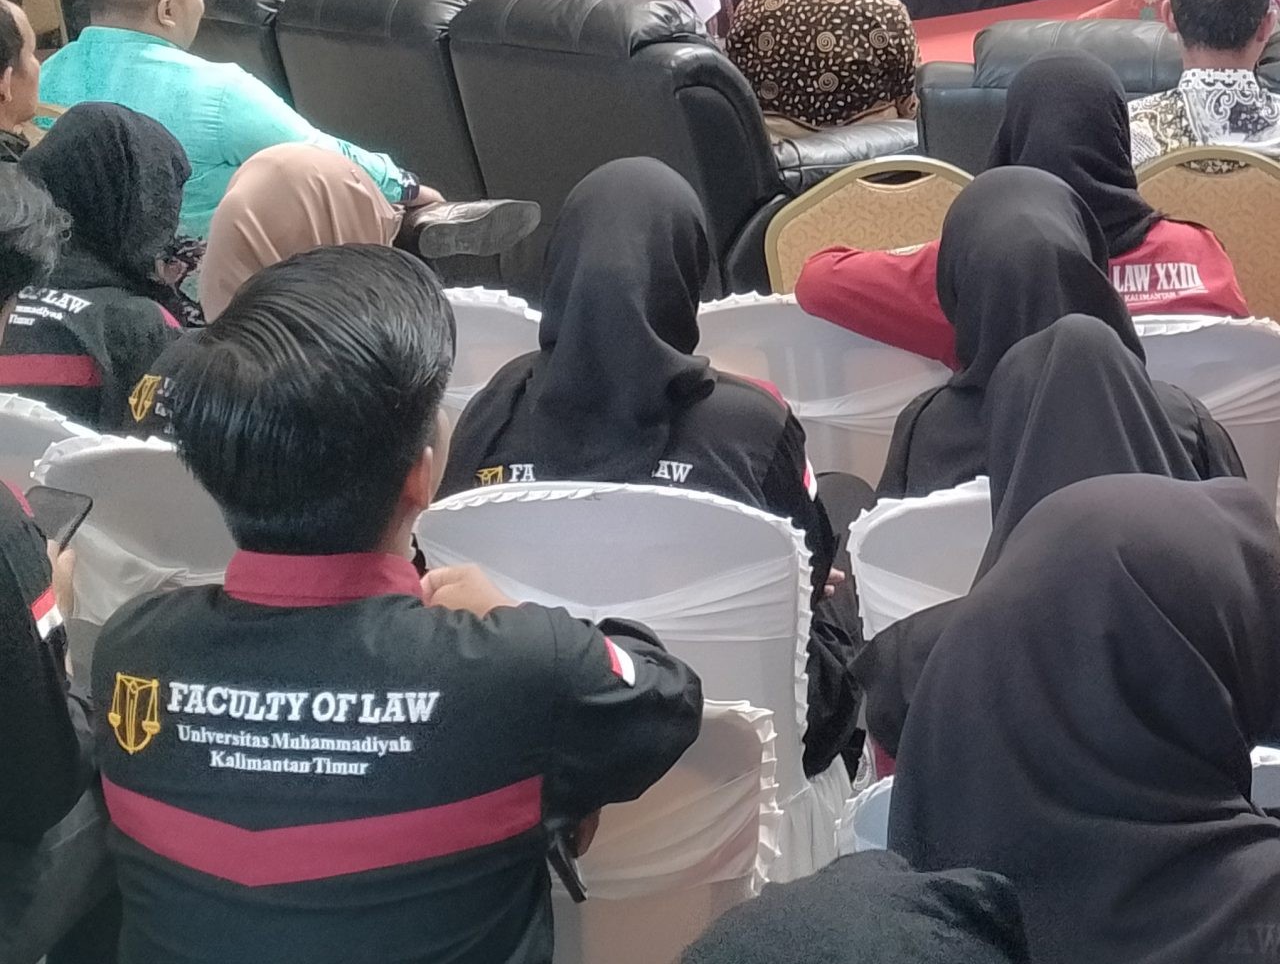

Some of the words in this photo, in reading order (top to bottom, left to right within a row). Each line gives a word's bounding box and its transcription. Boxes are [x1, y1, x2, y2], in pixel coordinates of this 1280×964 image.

[1112, 264, 1151, 293] LAW
[41, 289, 92, 314] LAW
[167, 681, 309, 721] FACULTY
[312, 692, 358, 722] OF
[358, 691, 440, 723] LAW
[177, 724, 270, 749] Universitas
[271, 733, 412, 757] Muhammadiyah
[209, 750, 310, 774] Kalimantan
[312, 757, 369, 775] Timur
